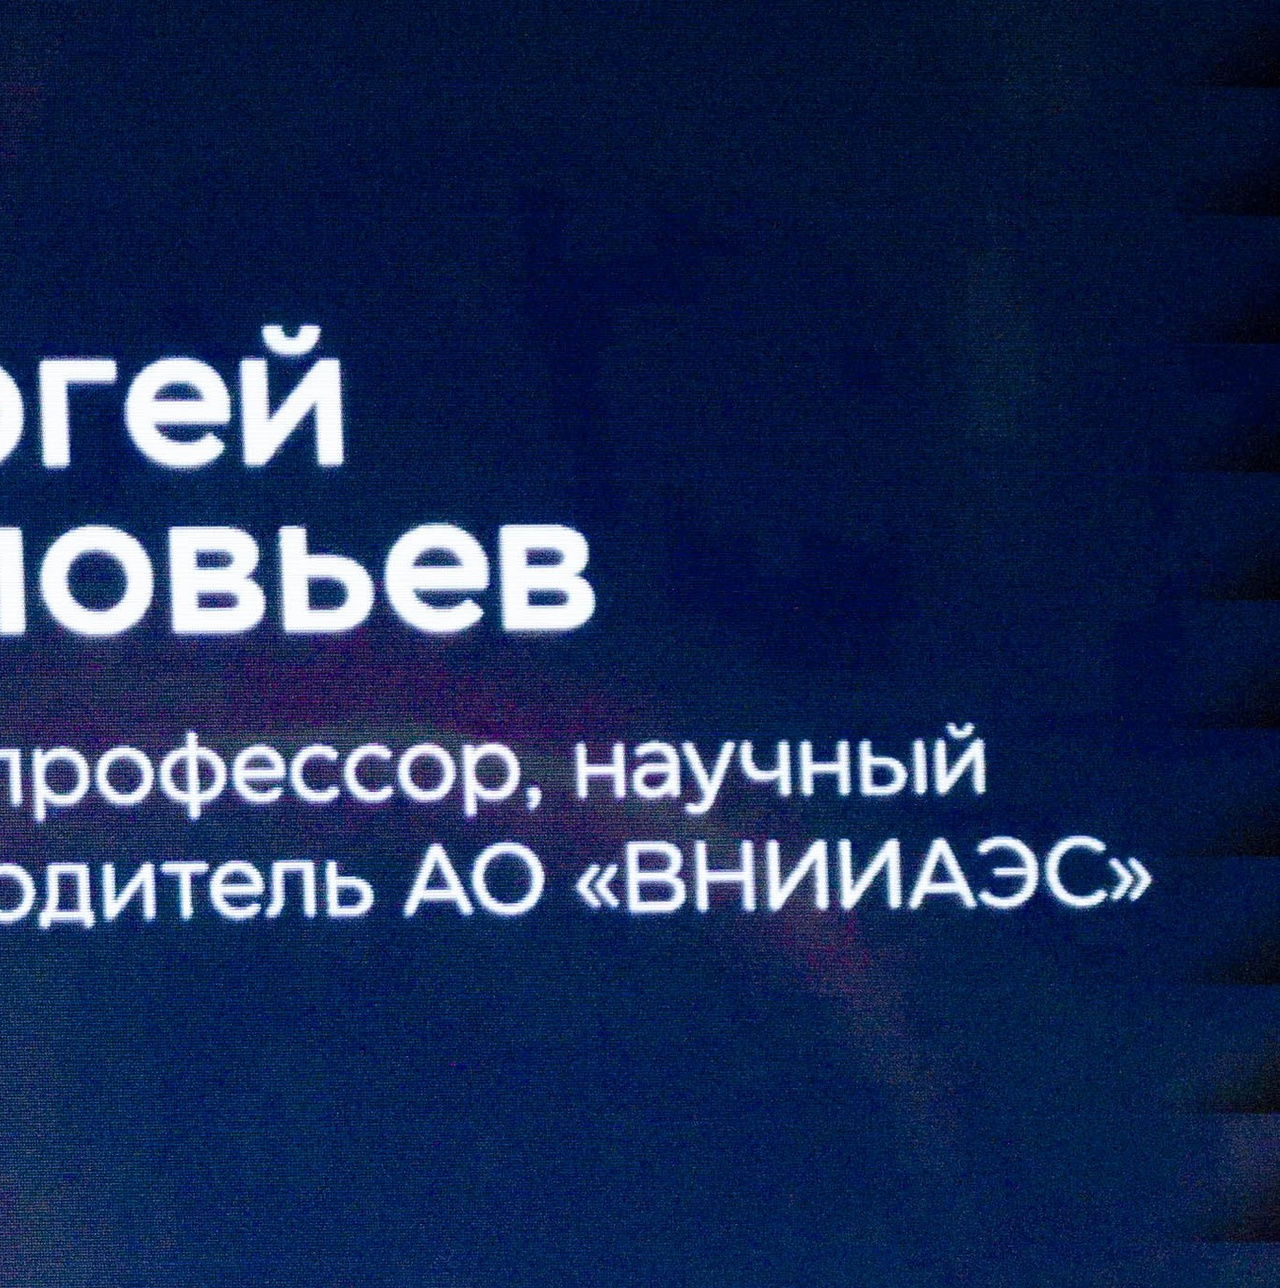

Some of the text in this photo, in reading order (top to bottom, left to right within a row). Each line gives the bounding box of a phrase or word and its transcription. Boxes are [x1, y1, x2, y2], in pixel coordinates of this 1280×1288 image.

[574, 722, 986, 817] научный
[404, 841, 546, 917] АО
[575, 835, 1153, 914] «ВНИИАЭС»
